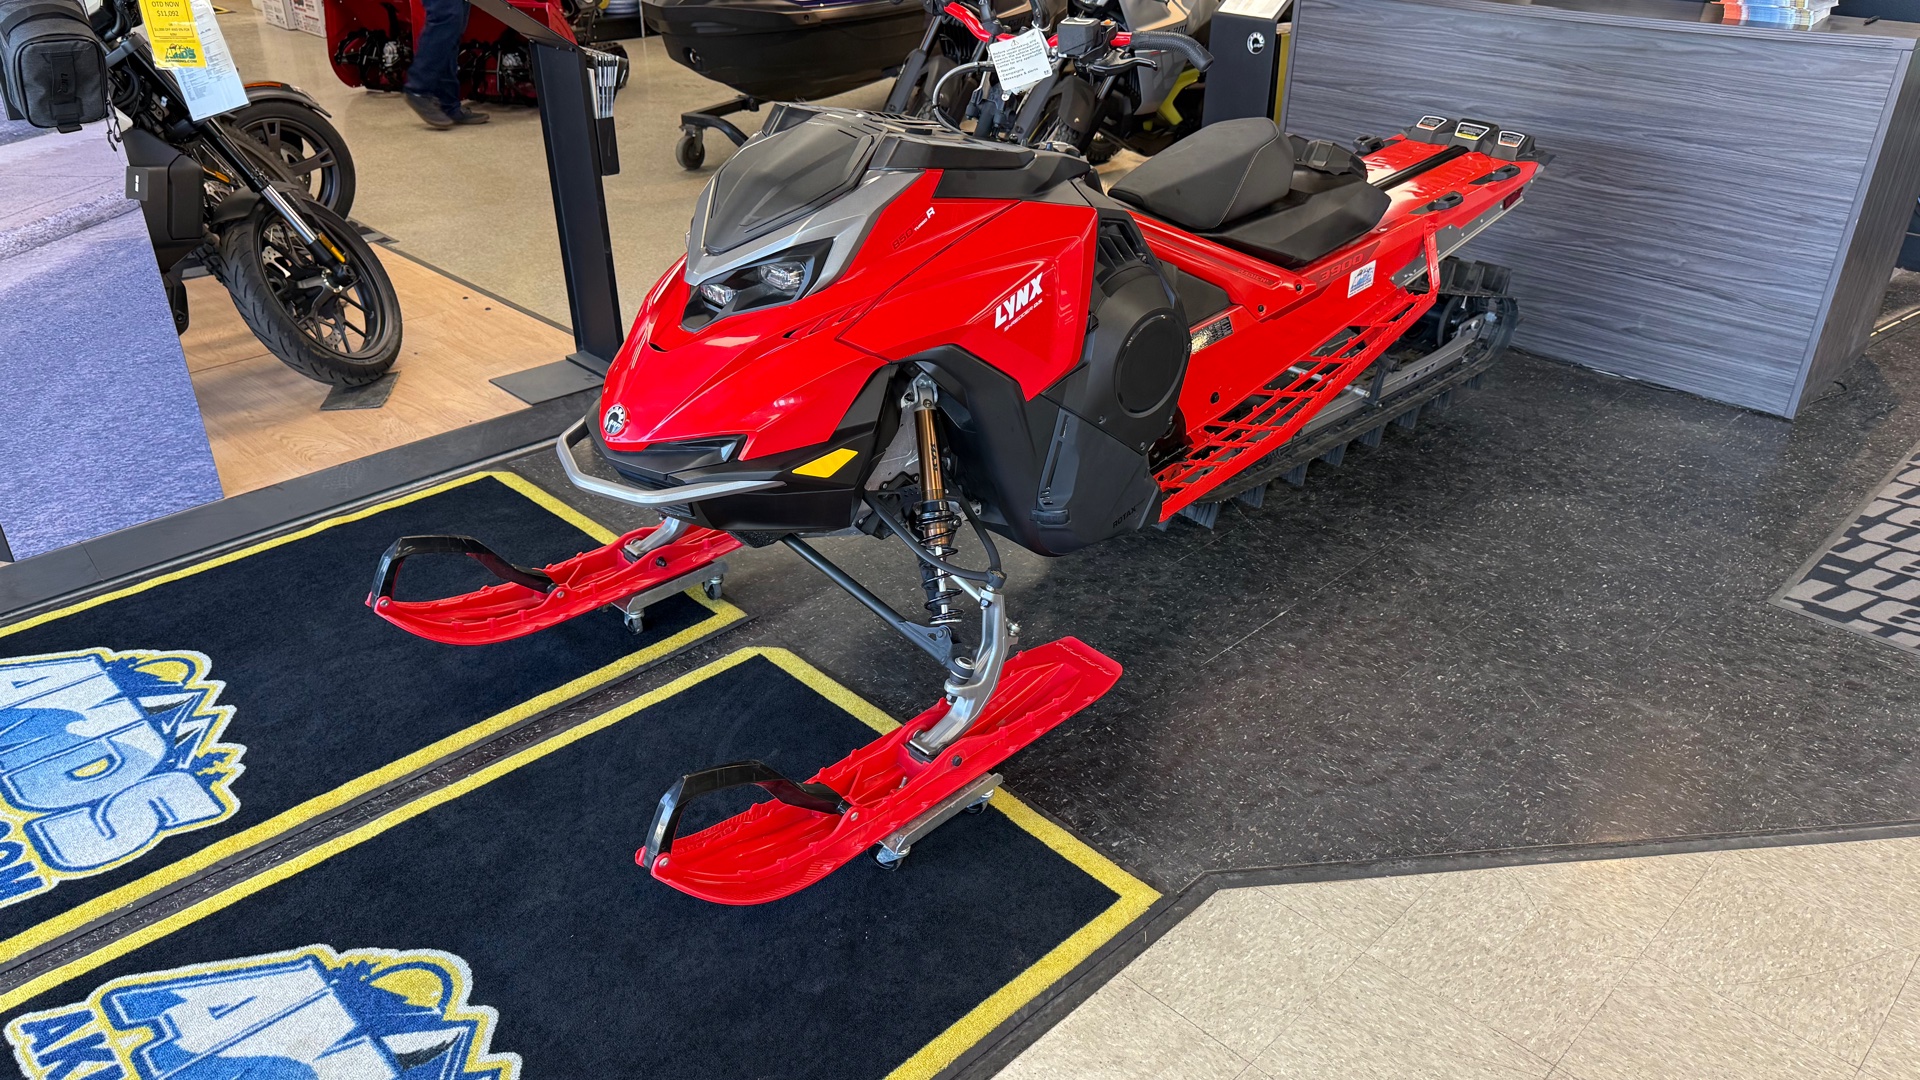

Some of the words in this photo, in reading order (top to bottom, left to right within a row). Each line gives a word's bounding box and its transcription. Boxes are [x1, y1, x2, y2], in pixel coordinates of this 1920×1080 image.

[892, 227, 914, 250] 850
[926, 206, 935, 219] R
[1319, 253, 1364, 283] 3900
[994, 271, 1043, 329] LYNX
[1112, 505, 1137, 529] ROTAX
